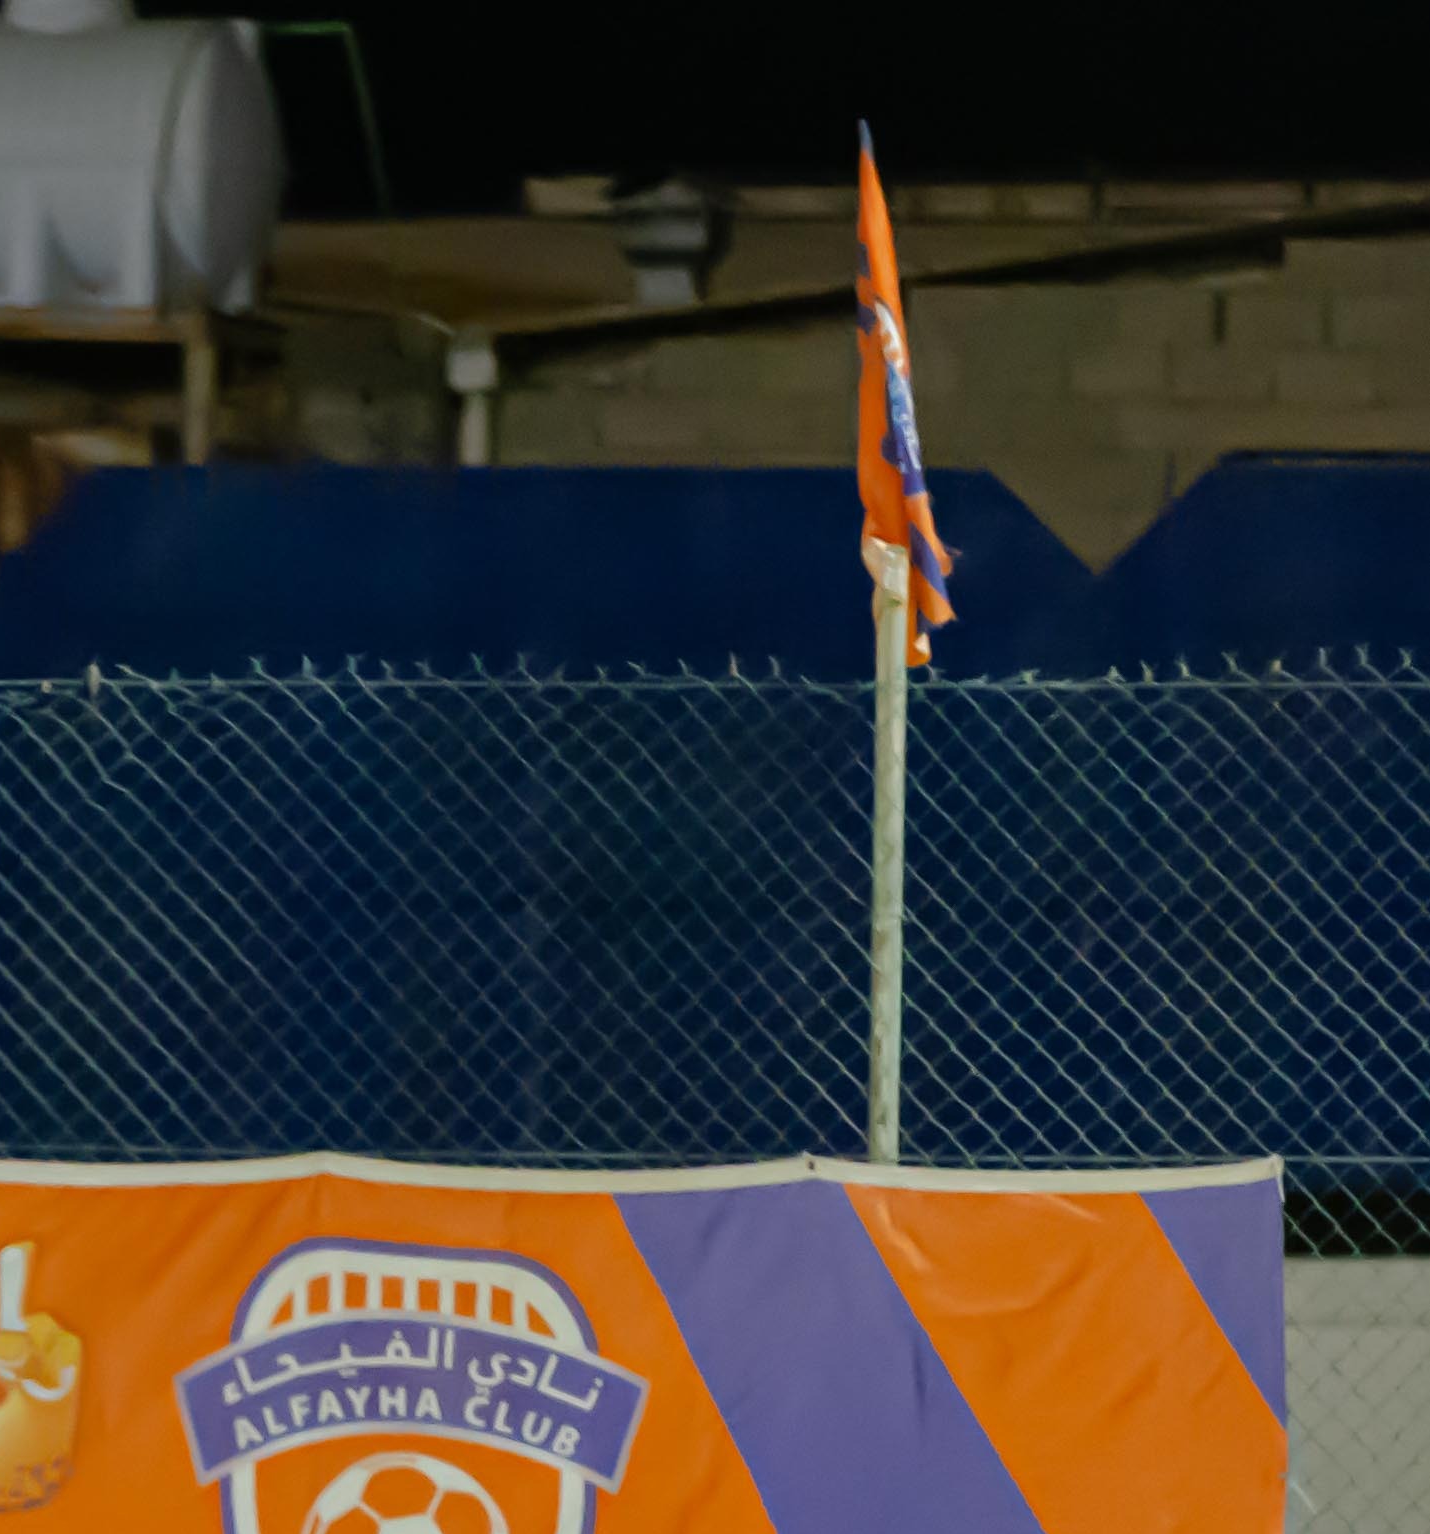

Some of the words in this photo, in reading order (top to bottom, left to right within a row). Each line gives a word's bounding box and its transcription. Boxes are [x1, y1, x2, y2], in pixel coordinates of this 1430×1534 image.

[222, 1327, 456, 1407] الفيحاء
[467, 1353, 604, 1412] نادي
[232, 1386, 443, 1450] ALFAYHA
[464, 1397, 583, 1458] CLUB
